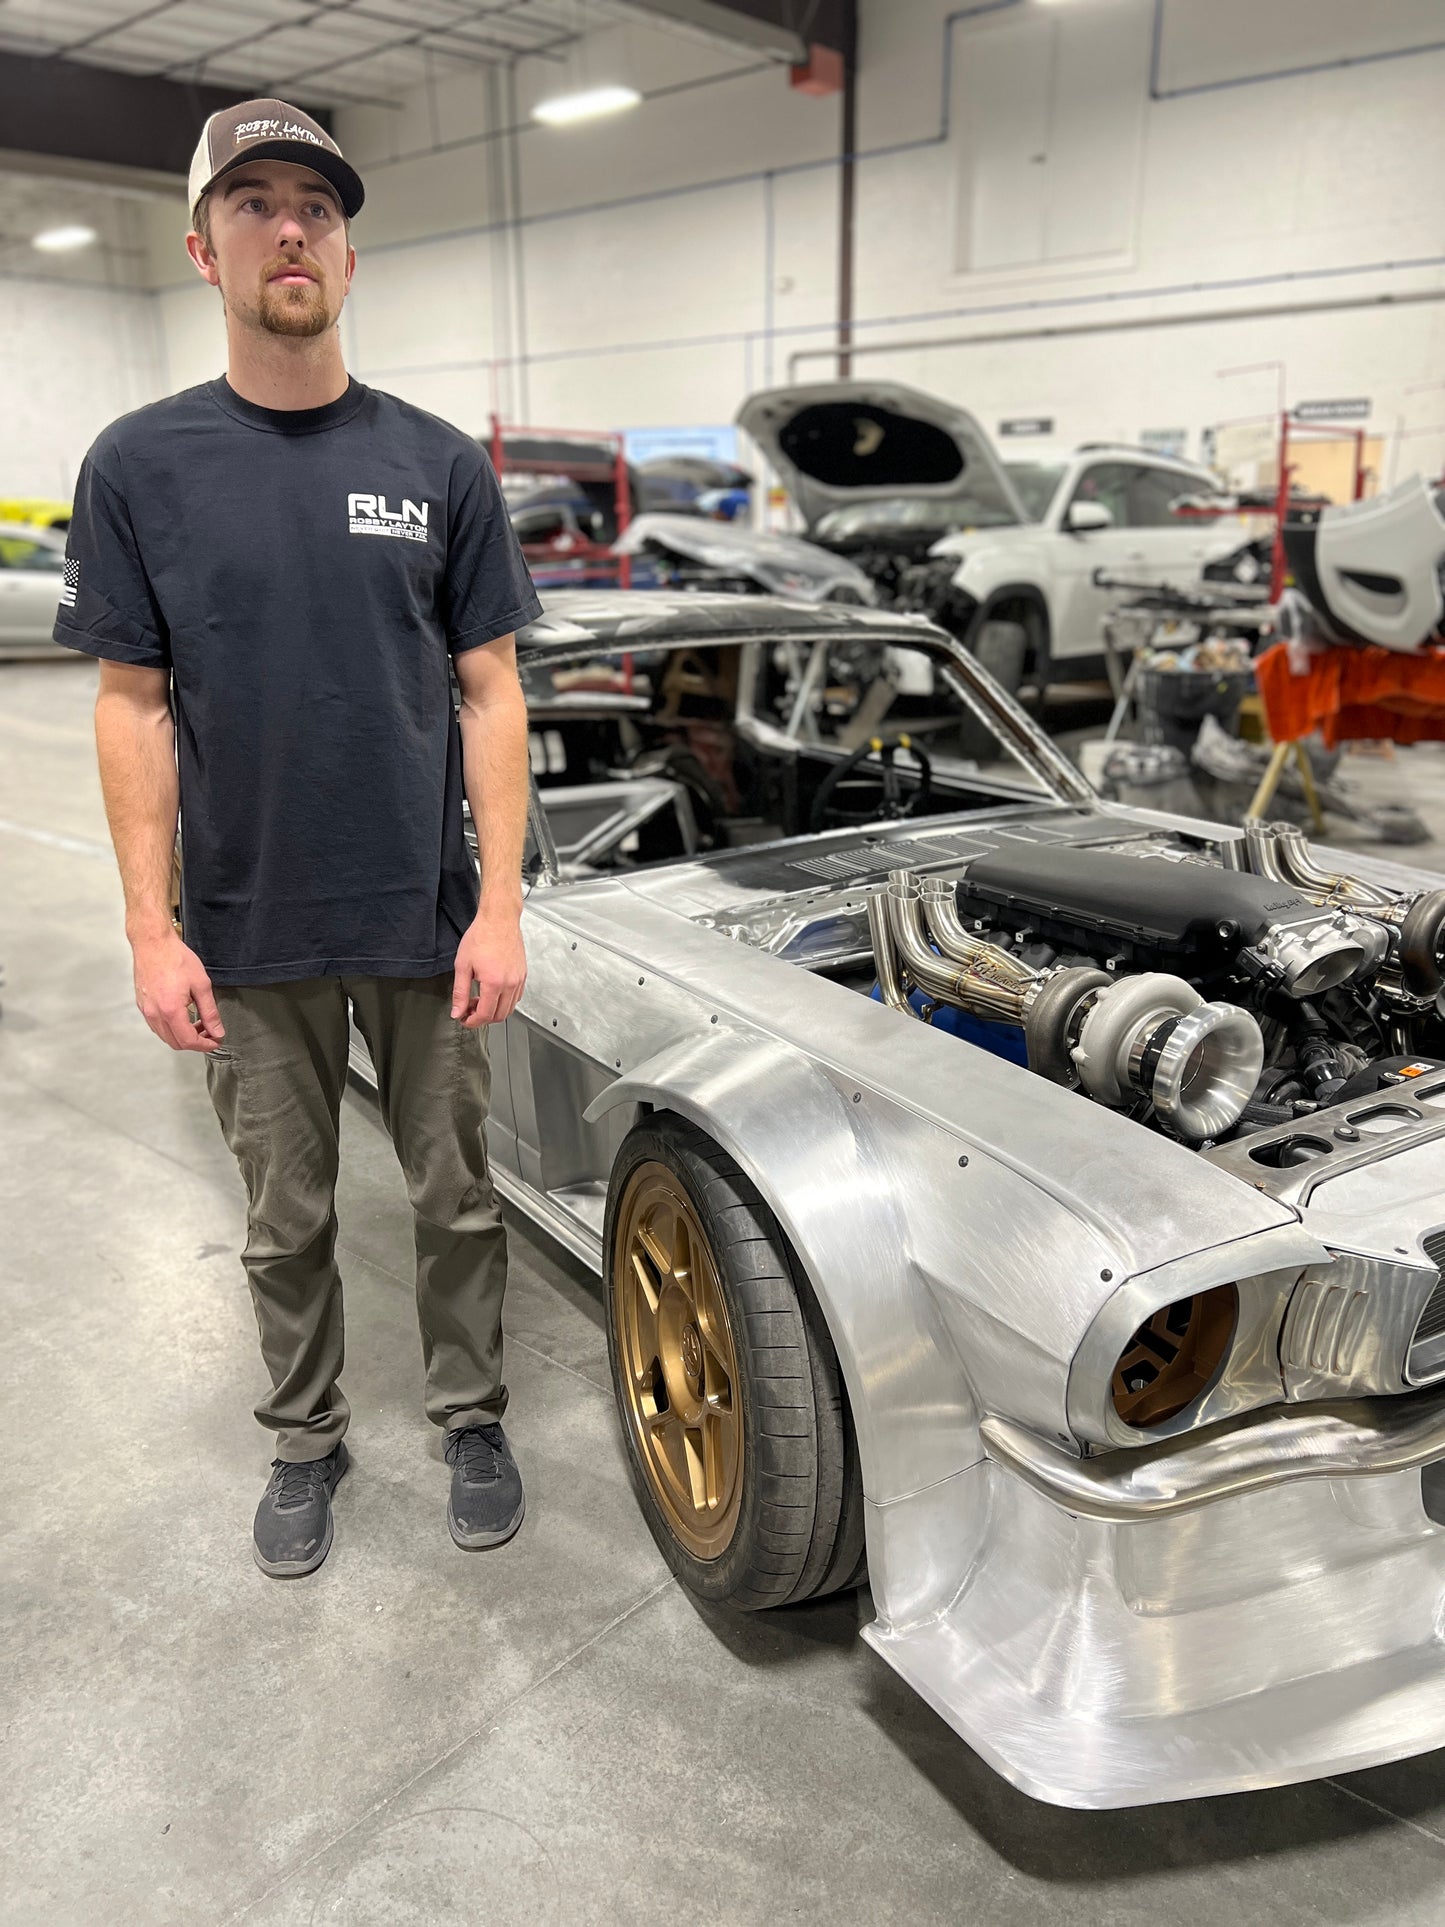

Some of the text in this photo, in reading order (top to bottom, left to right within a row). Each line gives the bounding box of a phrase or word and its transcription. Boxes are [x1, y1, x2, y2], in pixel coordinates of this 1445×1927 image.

[234, 119, 323, 146] ROBBY LAYTON
[348, 493, 429, 526] RLN
[349, 517, 387, 526] ROBBY
[388, 520, 428, 534] LAYTON
